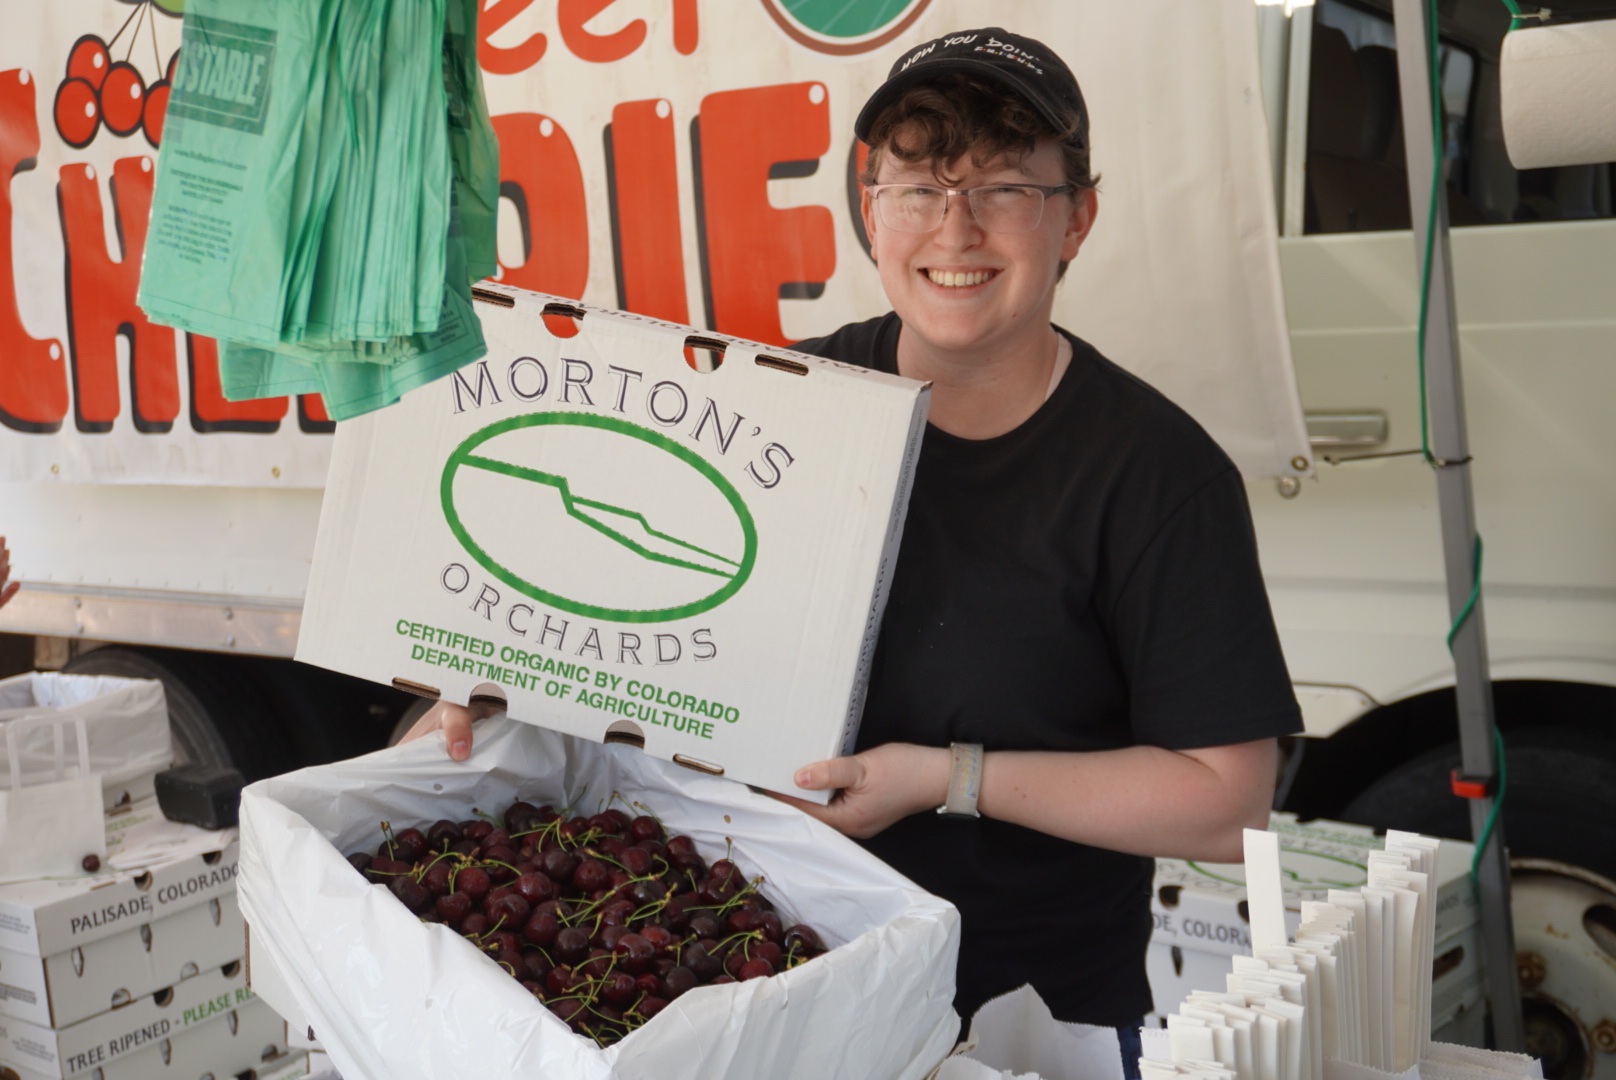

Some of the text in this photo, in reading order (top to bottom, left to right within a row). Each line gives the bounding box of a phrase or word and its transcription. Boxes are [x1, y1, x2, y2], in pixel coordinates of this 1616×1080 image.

[900, 43, 936, 72] HOW
[943, 34, 978, 49] YOU
[450, 356, 796, 490] MORTON'S
[440, 562, 717, 667] ORCHARDS
[395, 618, 741, 724] CERTIFIED ORGANIC BY COLORADO
[410, 643, 715, 740] DEPARTMENT OF AGRICULTURE
[67, 1045, 105, 1074] TREE
[109, 1018, 171, 1057] RIPENED
[182, 992, 232, 1026] PLEASE
